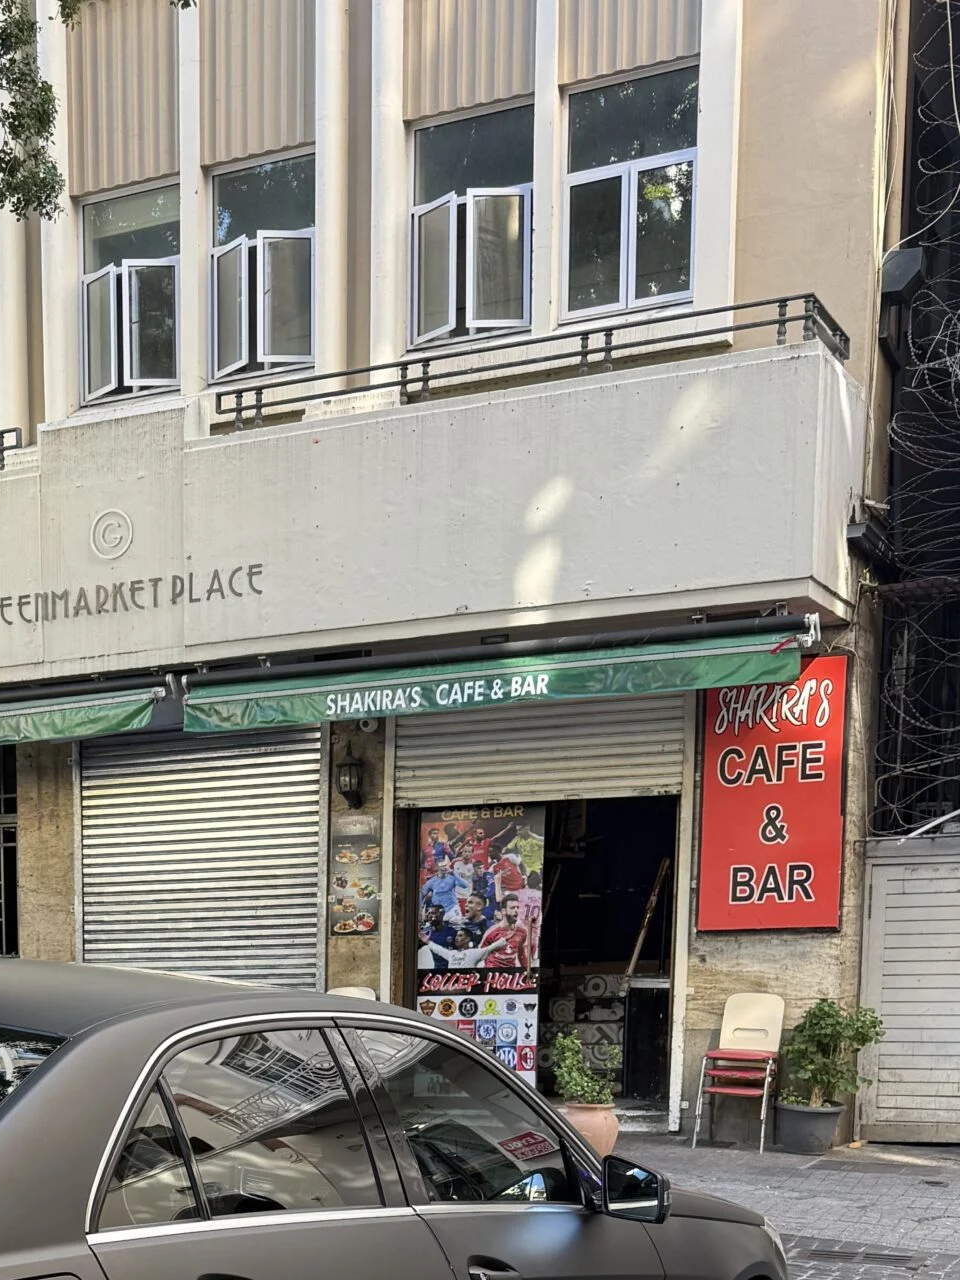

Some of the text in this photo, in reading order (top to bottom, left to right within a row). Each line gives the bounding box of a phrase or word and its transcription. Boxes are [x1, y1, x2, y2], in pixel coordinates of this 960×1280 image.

[170, 563, 263, 605] PLACE
[326, 674, 549, 715] SHAKIRA'S CAFE & BAR
[714, 678, 833, 736] SHAKIRA'S
[718, 740, 825, 787] CAFE
[481, 807, 491, 819] &
[493, 804, 524, 818] BAR
[759, 803, 789, 844] &
[729, 862, 815, 904] BAR
